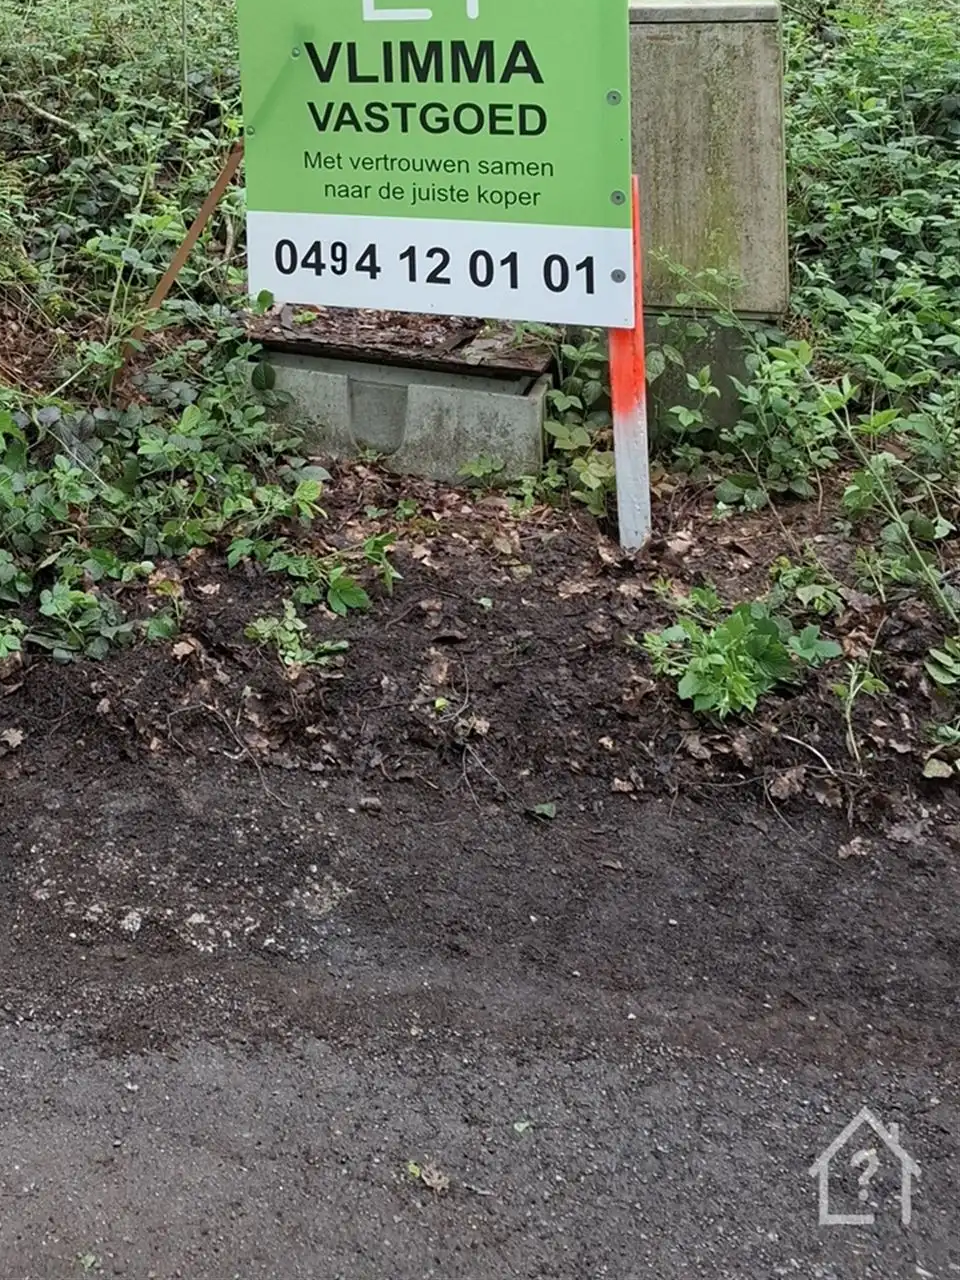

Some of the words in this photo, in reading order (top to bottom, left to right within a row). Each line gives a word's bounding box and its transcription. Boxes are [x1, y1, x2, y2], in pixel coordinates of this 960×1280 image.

[304, 39, 544, 84] VLIMMA
[307, 101, 548, 136] VASTGOED
[303, 151, 343, 171] Met
[349, 154, 470, 174] vertrouwen
[477, 159, 554, 177] samen
[324, 183, 371, 199] naar
[378, 182, 405, 201] de
[409, 185, 470, 206] juiste
[477, 187, 541, 210] koper
[274, 238, 382, 280] 0494
[398, 245, 451, 285] 12
[468, 249, 519, 290] 01
[542, 253, 596, 295] 01
